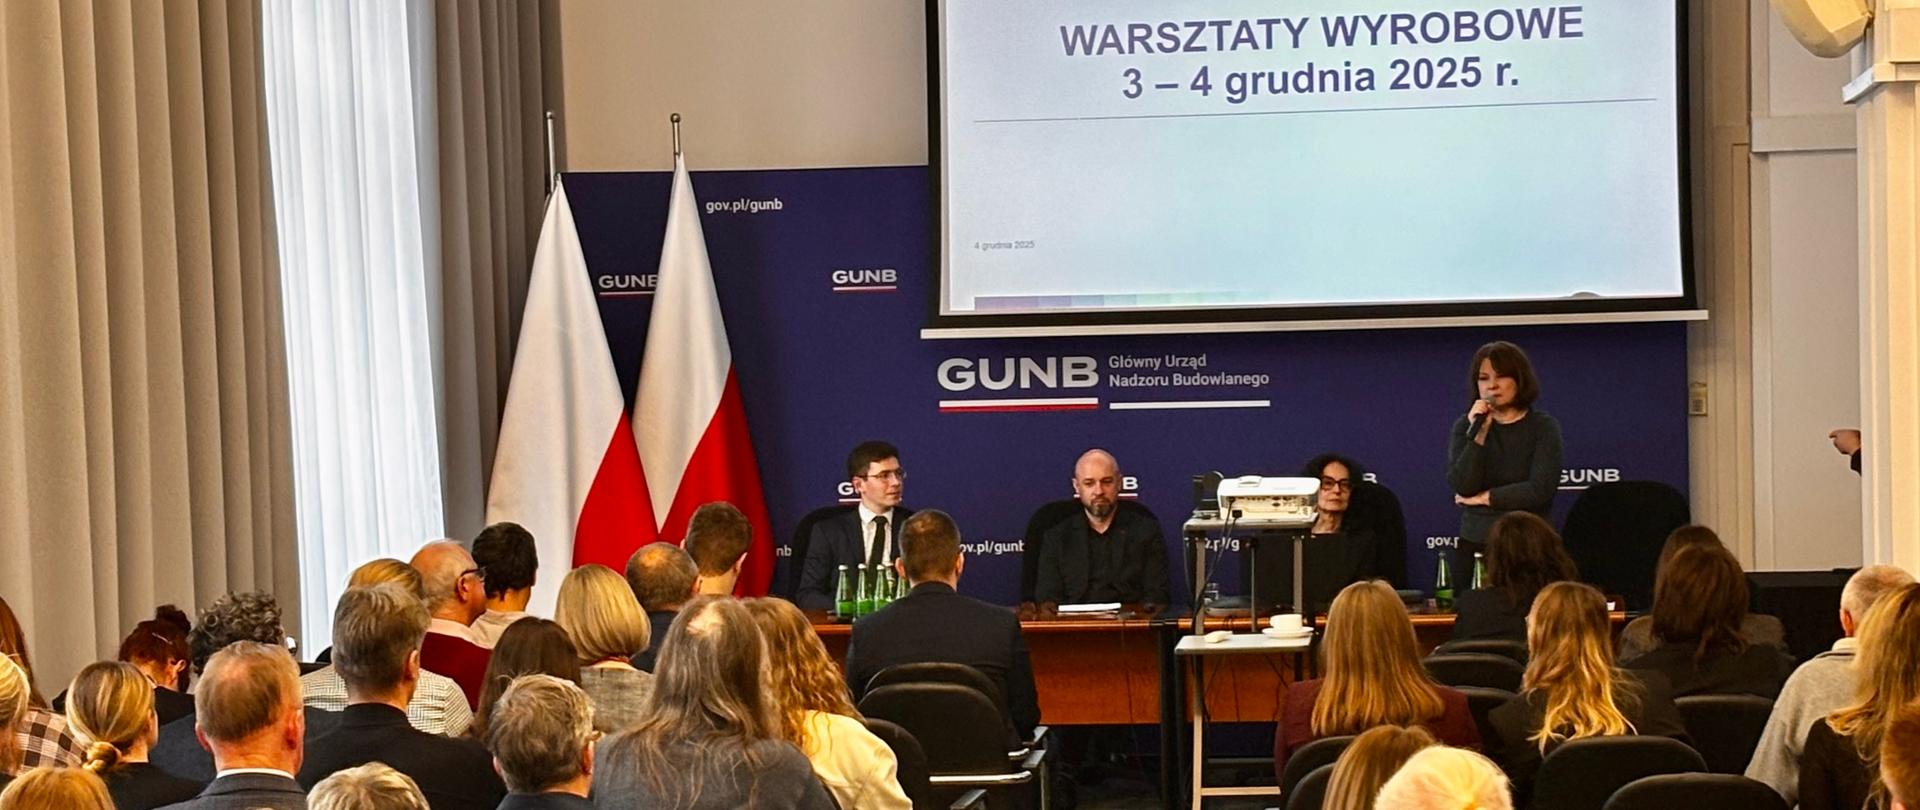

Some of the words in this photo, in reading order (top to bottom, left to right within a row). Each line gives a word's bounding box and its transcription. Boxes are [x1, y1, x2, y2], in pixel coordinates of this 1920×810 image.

[1060, 17, 1309, 56] WARSZTATY
[1320, 6, 1584, 48] WYROBOWE
[1122, 67, 1143, 99] 3
[1190, 65, 1213, 97] 4
[1225, 61, 1375, 104] grudnia
[1389, 56, 1482, 91] 2025
[1496, 61, 1519, 87] r.
[705, 198, 784, 214] gov.pl/gunb
[832, 269, 898, 284] GUNB
[1108, 354, 1161, 371] Główny
[1165, 353, 1207, 370] Urząd
[937, 355, 1100, 391] GUNB
[1109, 373, 1169, 388] Nadzoru
[1172, 371, 1270, 388] Budowlanego
